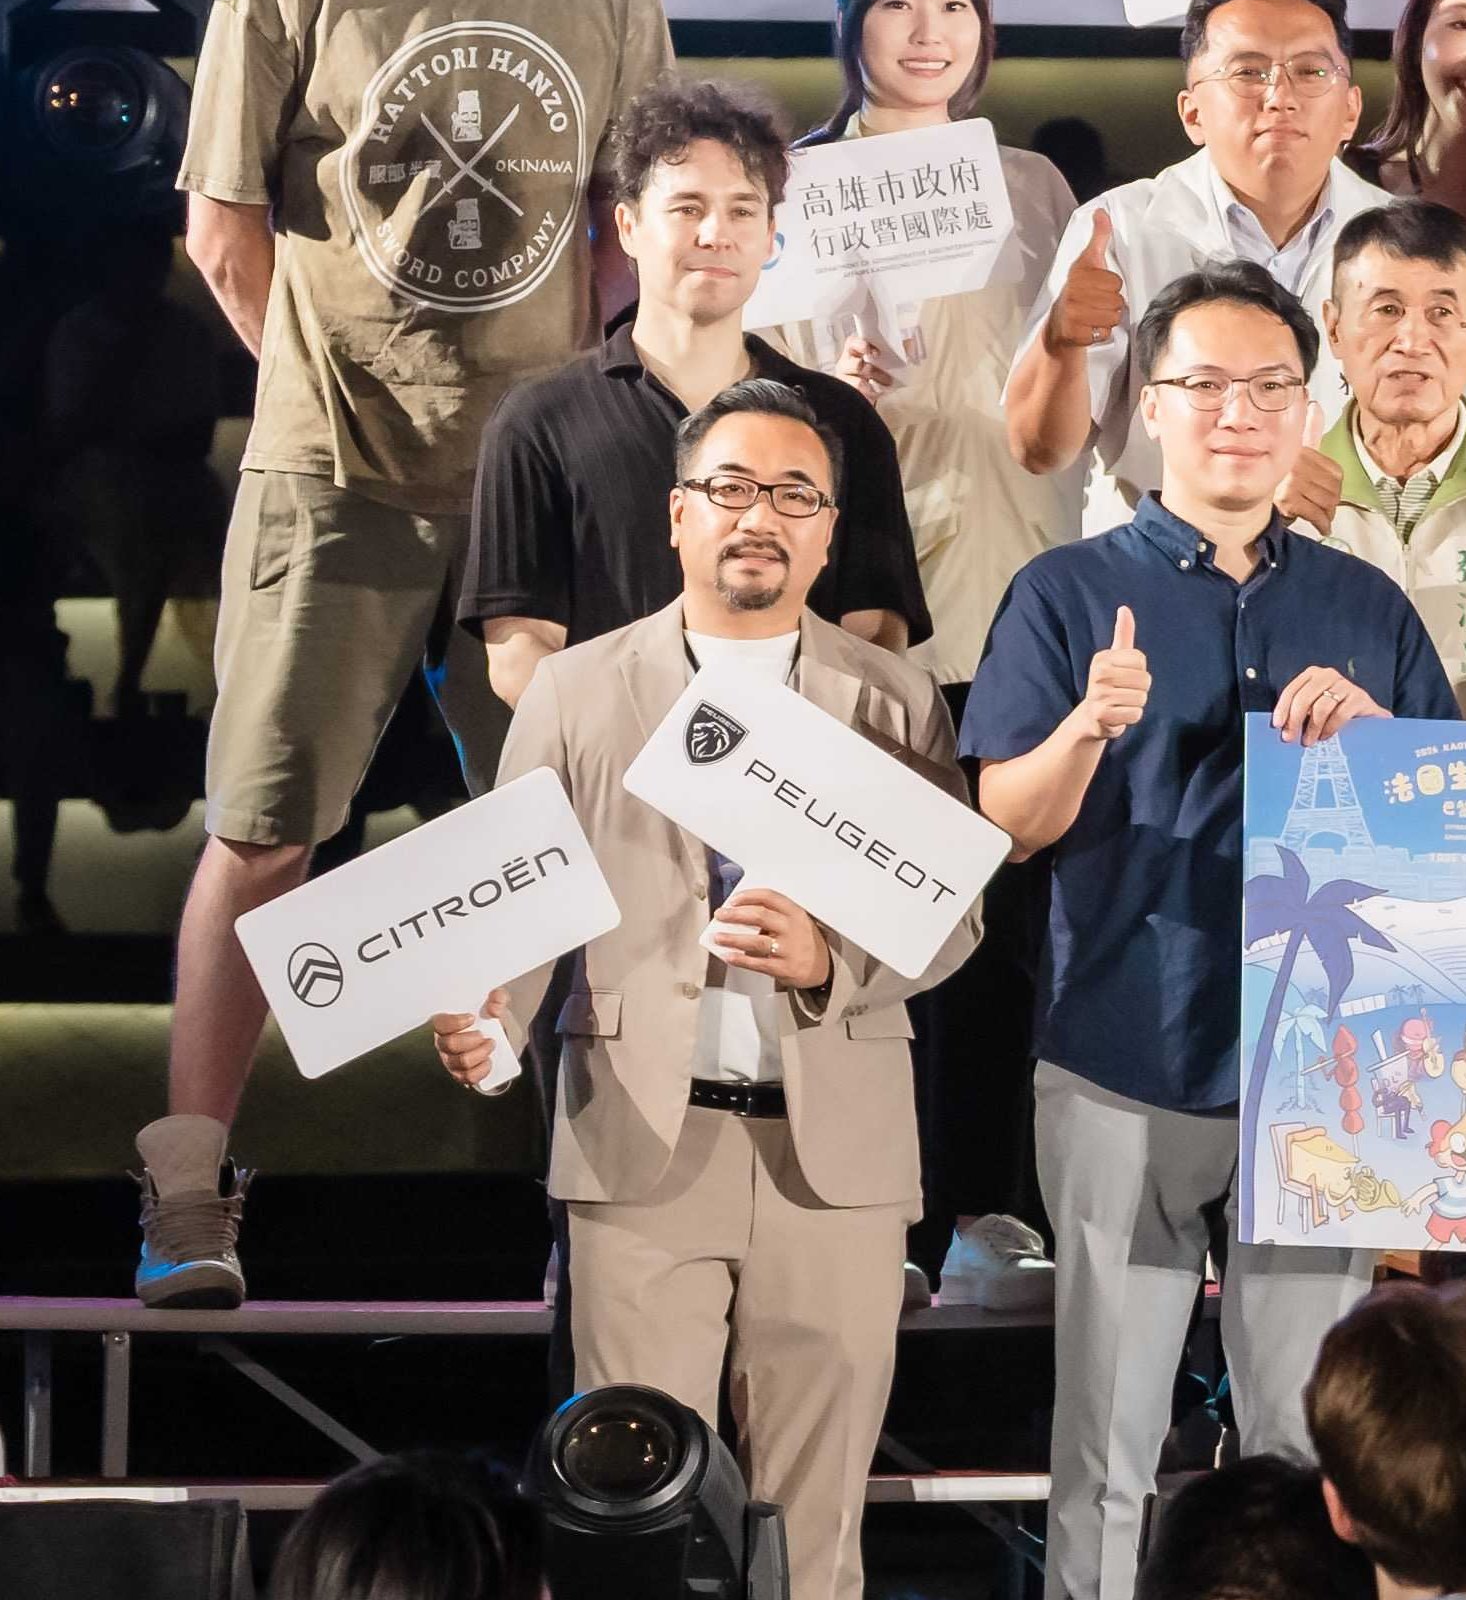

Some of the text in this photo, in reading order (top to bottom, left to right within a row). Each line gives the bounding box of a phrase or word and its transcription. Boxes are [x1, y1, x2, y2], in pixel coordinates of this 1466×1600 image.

[367, 46, 568, 145] HATTORI HANZO
[495, 159, 574, 174] OKINAWA
[797, 156, 981, 221] 高雄市政府
[376, 210, 557, 288] SWORD COMPANY
[809, 199, 994, 259] 行政暨國際處
[744, 758, 957, 905] PEUGEOT
[355, 845, 570, 964] CITROËN
